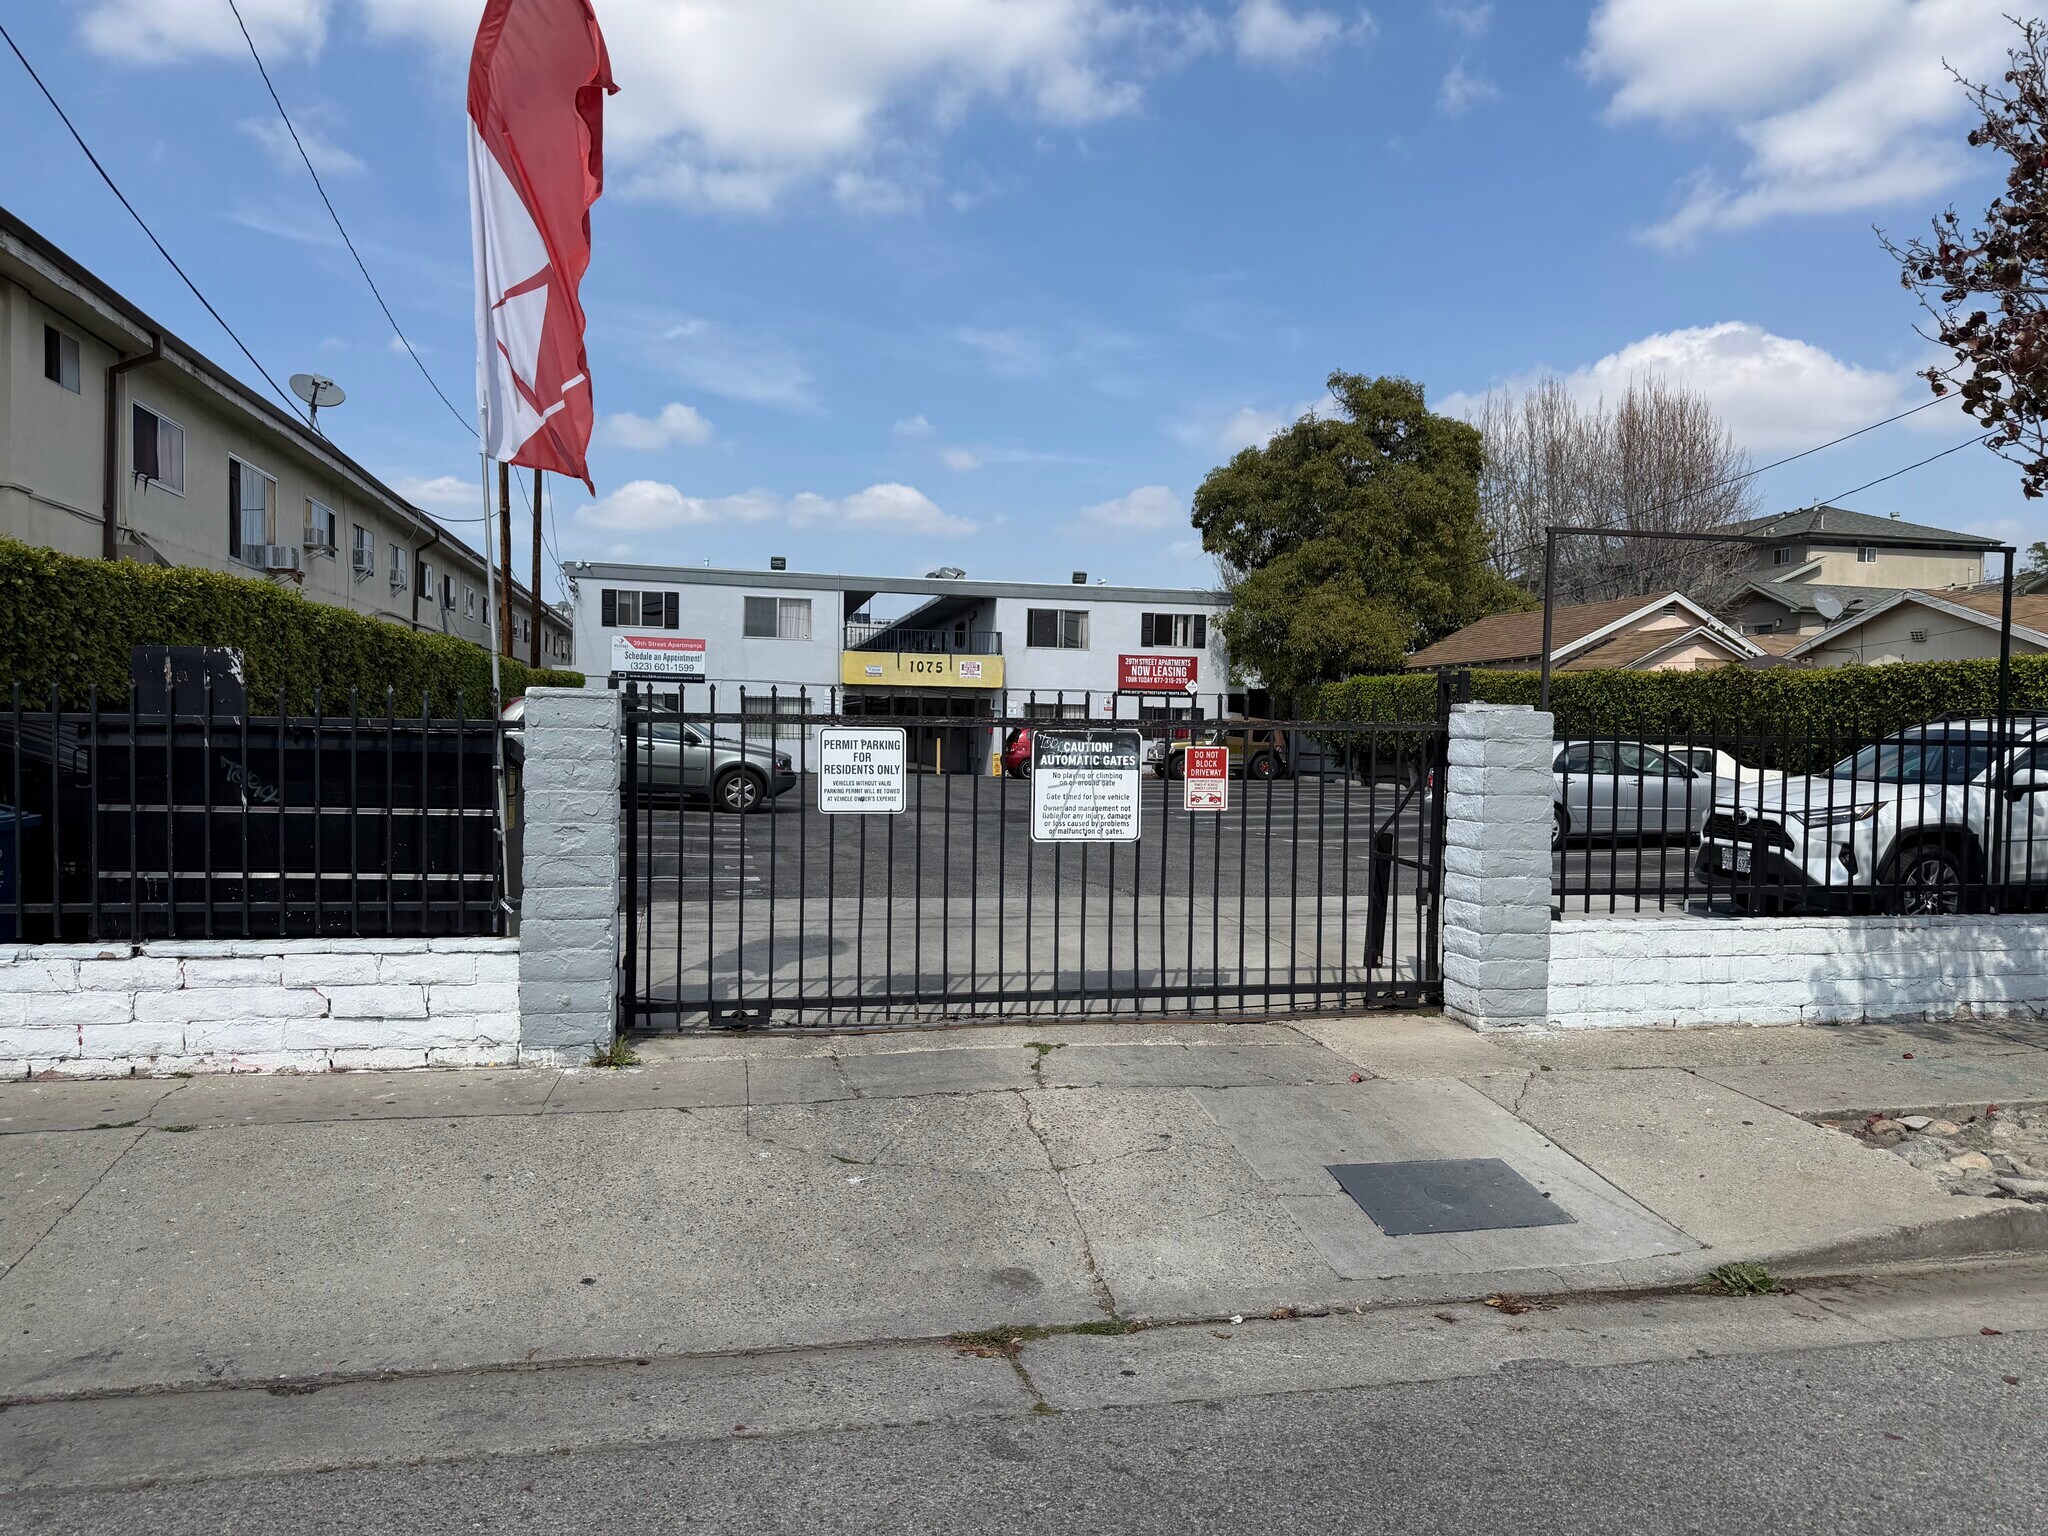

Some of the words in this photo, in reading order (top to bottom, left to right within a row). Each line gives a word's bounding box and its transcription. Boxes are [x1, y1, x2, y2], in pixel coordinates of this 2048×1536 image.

[625, 651, 653, 660] Schedule
[663, 653, 702, 663] Appointment!
[630, 662, 652, 671] (323)
[654, 663, 694, 672] 601-1599
[910, 661, 943, 673] 1075
[1132, 666, 1150, 676] NOW
[1153, 666, 1187, 677] LEASING
[824, 740, 858, 749] PERMIT
[861, 740, 900, 750] PARKING
[1064, 742, 1113, 753] CAUTION!
[853, 753, 871, 762] FOR
[1040, 755, 1100, 766] AUTOMATIC
[1103, 756, 1136, 766] GATES
[824, 764, 874, 775] RESIDENTS
[877, 765, 900, 775] ONLY
